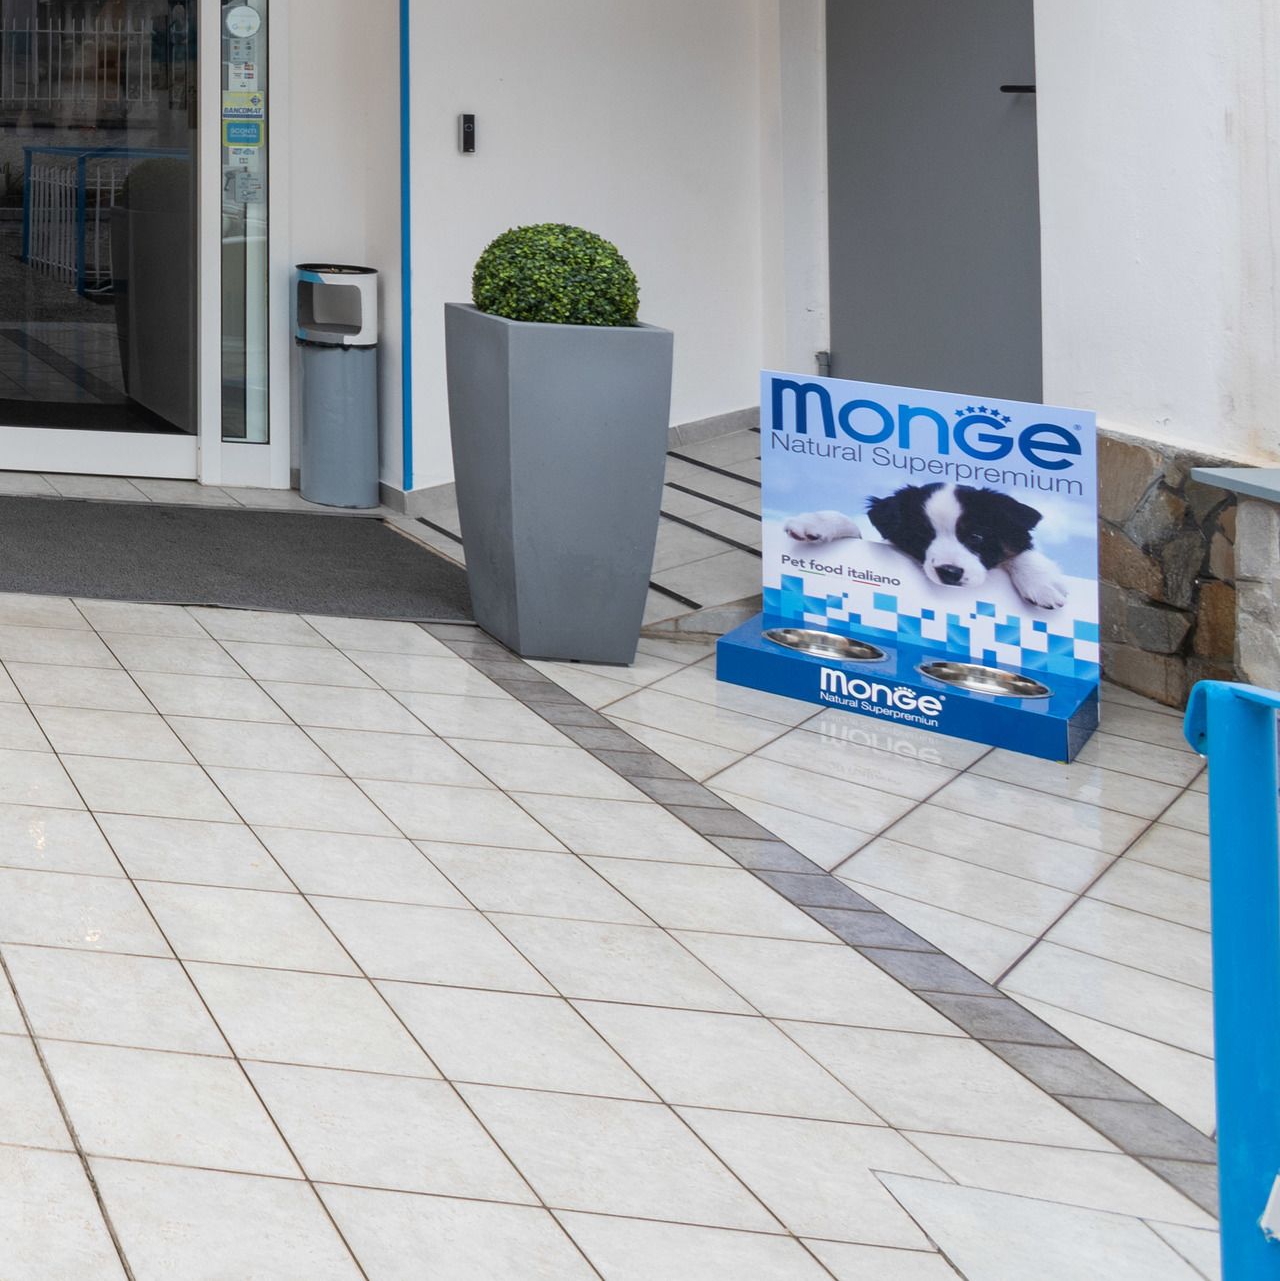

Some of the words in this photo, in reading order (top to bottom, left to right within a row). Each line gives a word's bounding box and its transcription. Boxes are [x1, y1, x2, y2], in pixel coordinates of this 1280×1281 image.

[224, 106, 262, 114] BANCOMAT
[771, 431, 862, 463] Natural
[872, 446, 1084, 496] Superpremium
[781, 554, 806, 569] Pet
[809, 559, 843, 576] food
[847, 566, 901, 587] italiano
[819, 690, 859, 708] Natural
